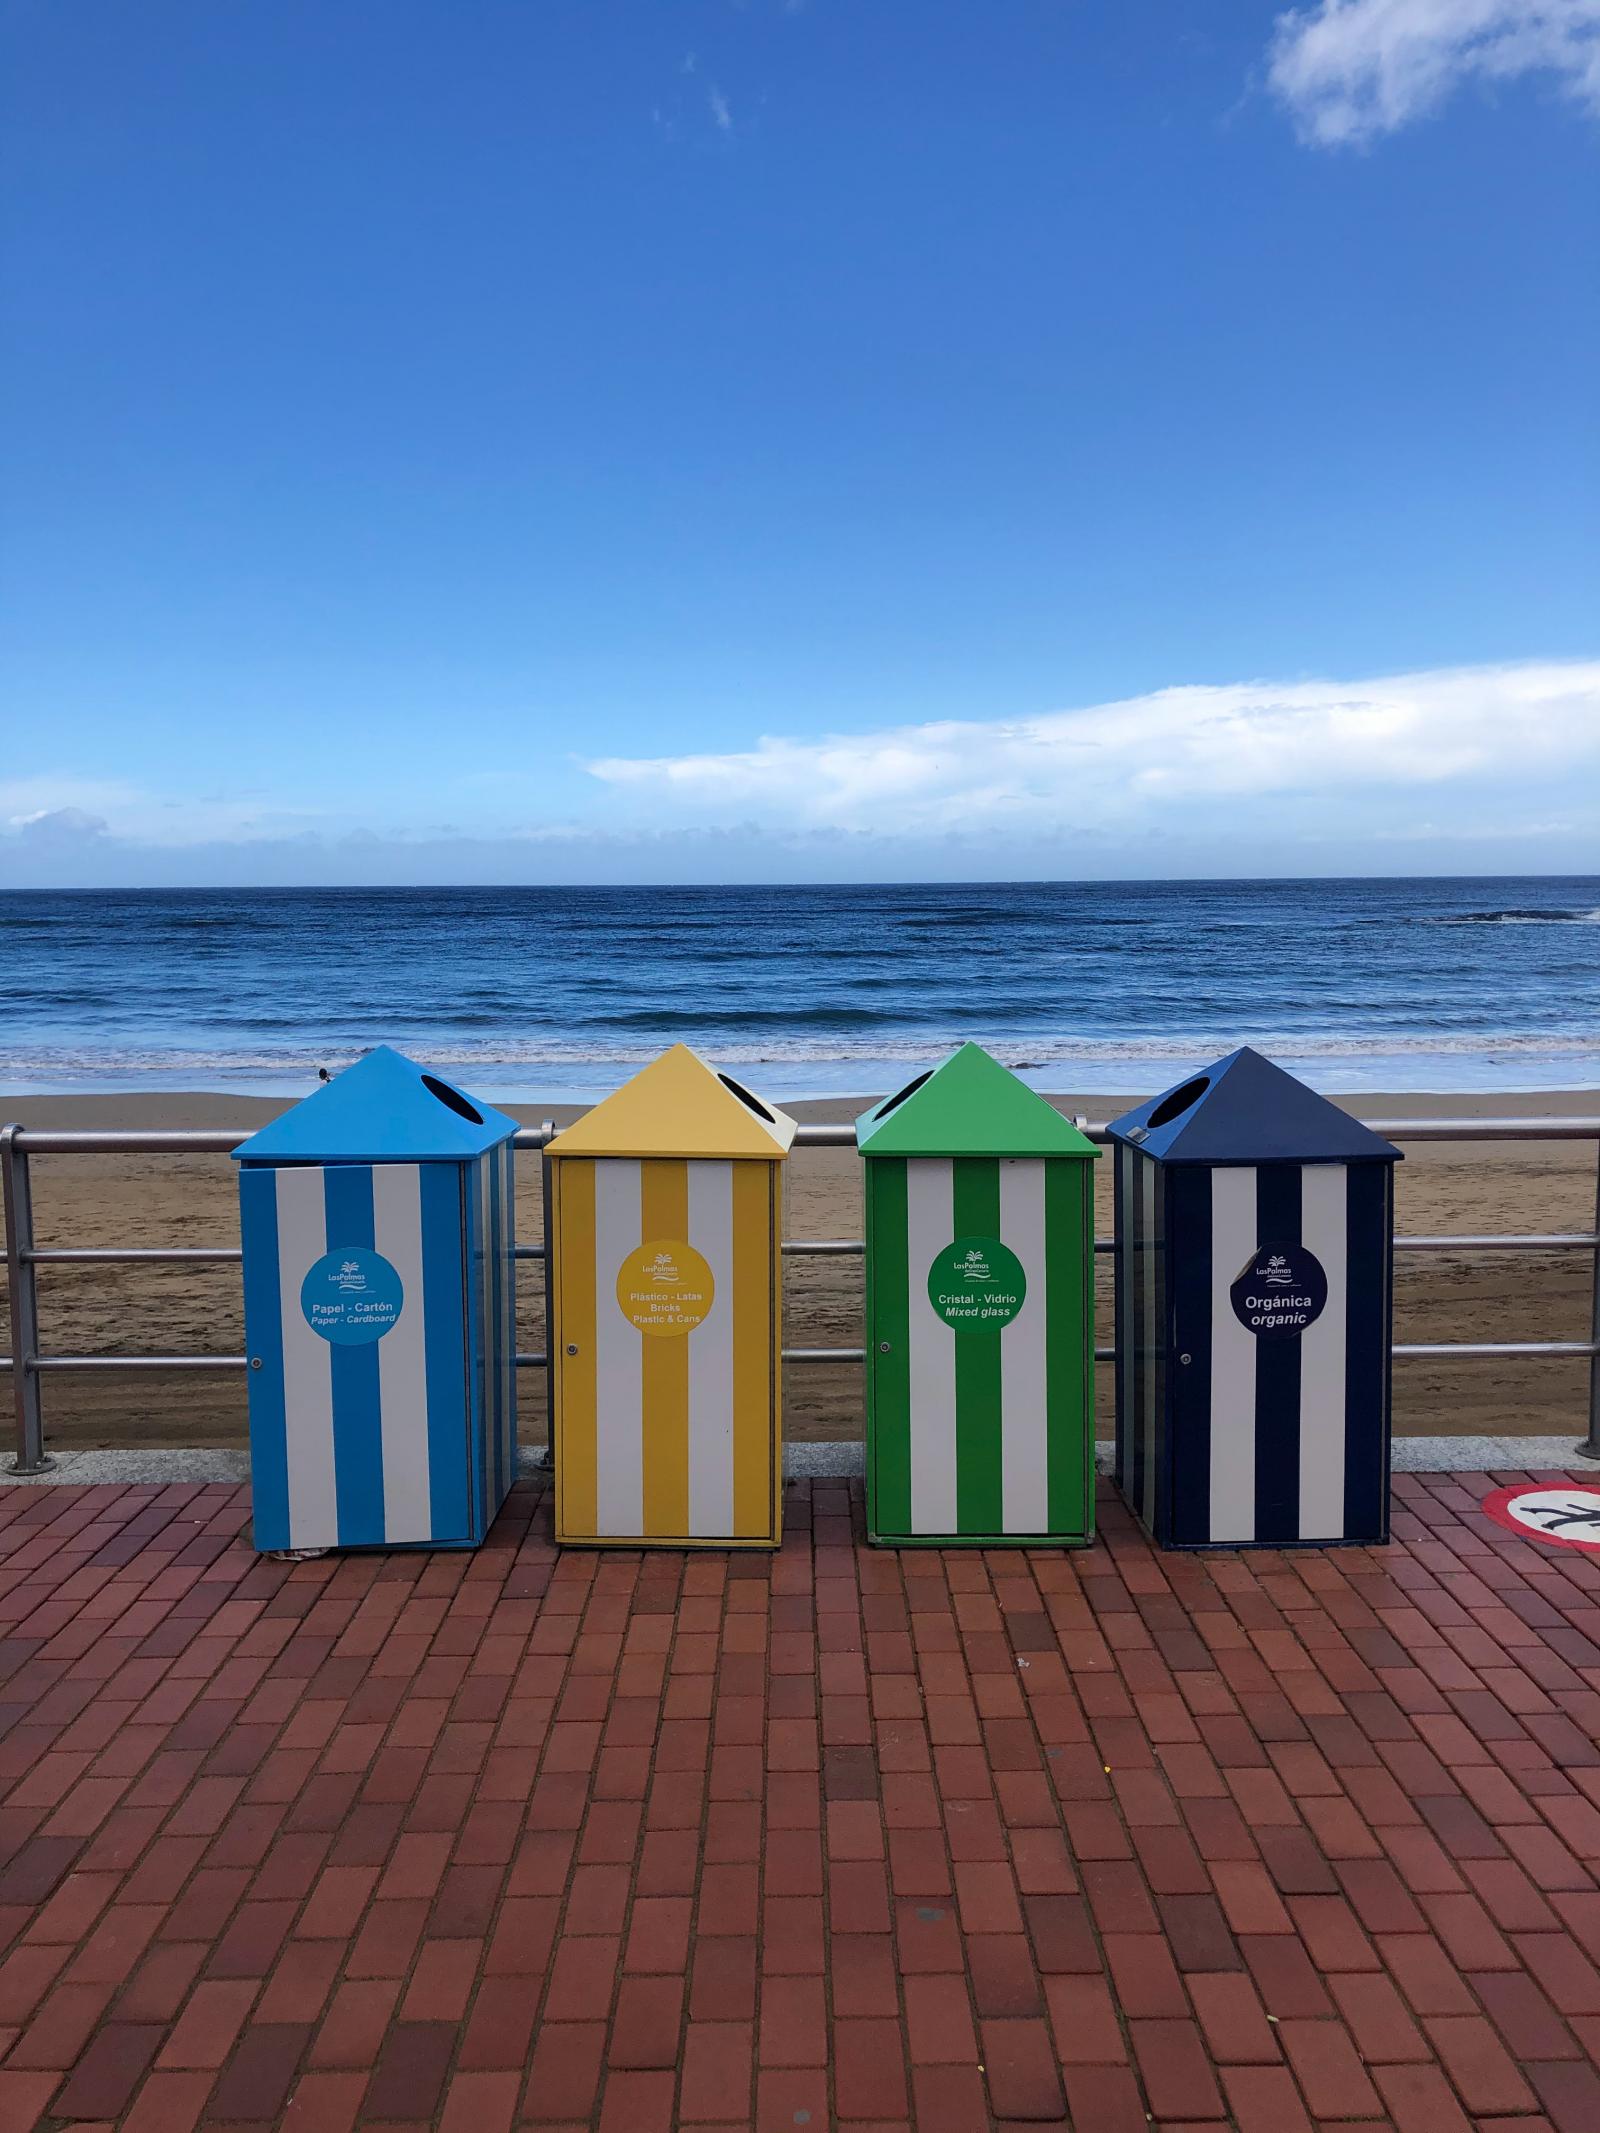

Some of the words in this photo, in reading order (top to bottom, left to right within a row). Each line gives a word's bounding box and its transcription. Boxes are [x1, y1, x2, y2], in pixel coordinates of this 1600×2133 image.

[630, 1293, 668, 1301] Plástico
[676, 1293, 702, 1301] Latas
[938, 1294, 974, 1304] Cristal
[984, 1294, 1017, 1304] Vidrio
[1245, 1295, 1312, 1311] Orgánica
[312, 1304, 344, 1315] Papel
[354, 1302, 393, 1312] Cartón
[650, 1303, 681, 1312] Bricks
[945, 1307, 979, 1317] Mixed
[981, 1307, 1011, 1319] glass
[311, 1316, 339, 1326] Paper
[346, 1314, 396, 1323] Cardboard
[633, 1314, 665, 1323] Plastic
[667, 1315, 674, 1323] &
[676, 1314, 701, 1323] Cans
[1251, 1312, 1307, 1328] organic
